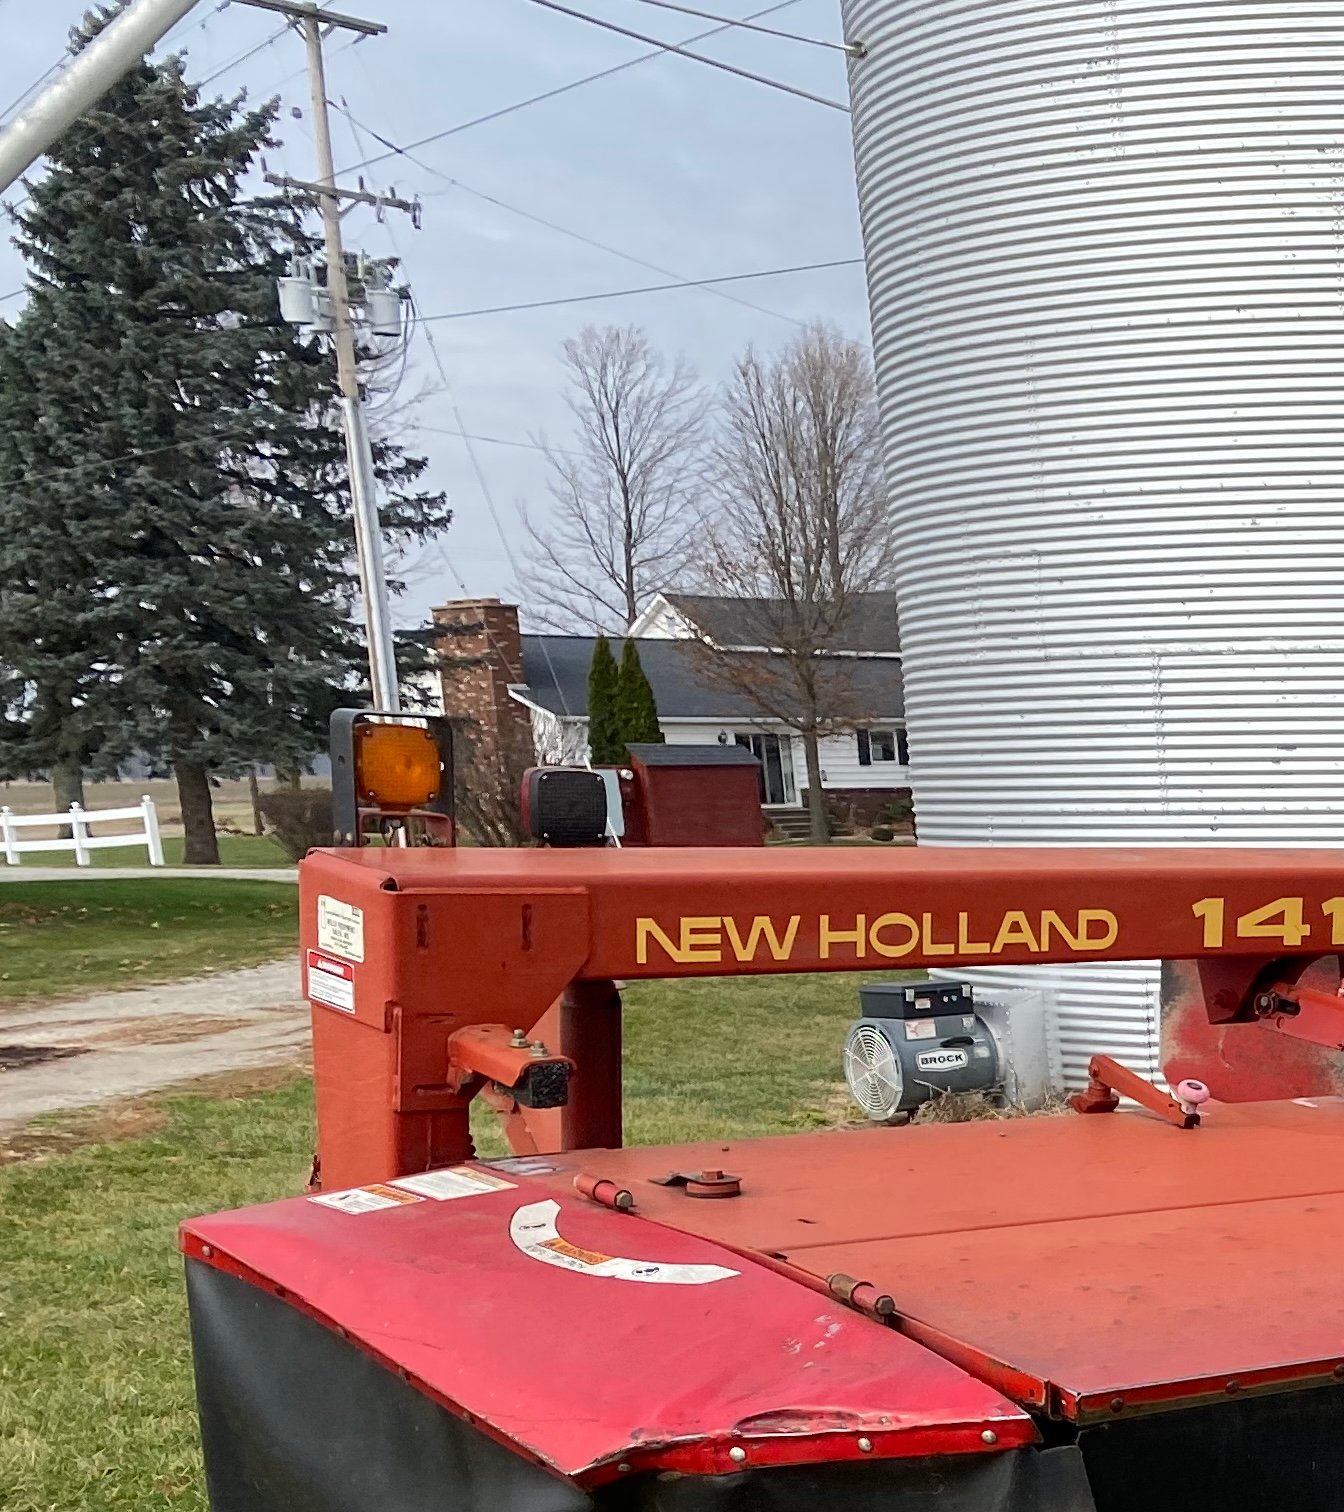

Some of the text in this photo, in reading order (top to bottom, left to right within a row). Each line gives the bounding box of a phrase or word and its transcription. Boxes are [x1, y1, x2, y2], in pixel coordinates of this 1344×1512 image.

[636, 915, 801, 964] NEW
[819, 910, 1119, 958] HOLLAND
[921, 1054, 964, 1065] BROCK
